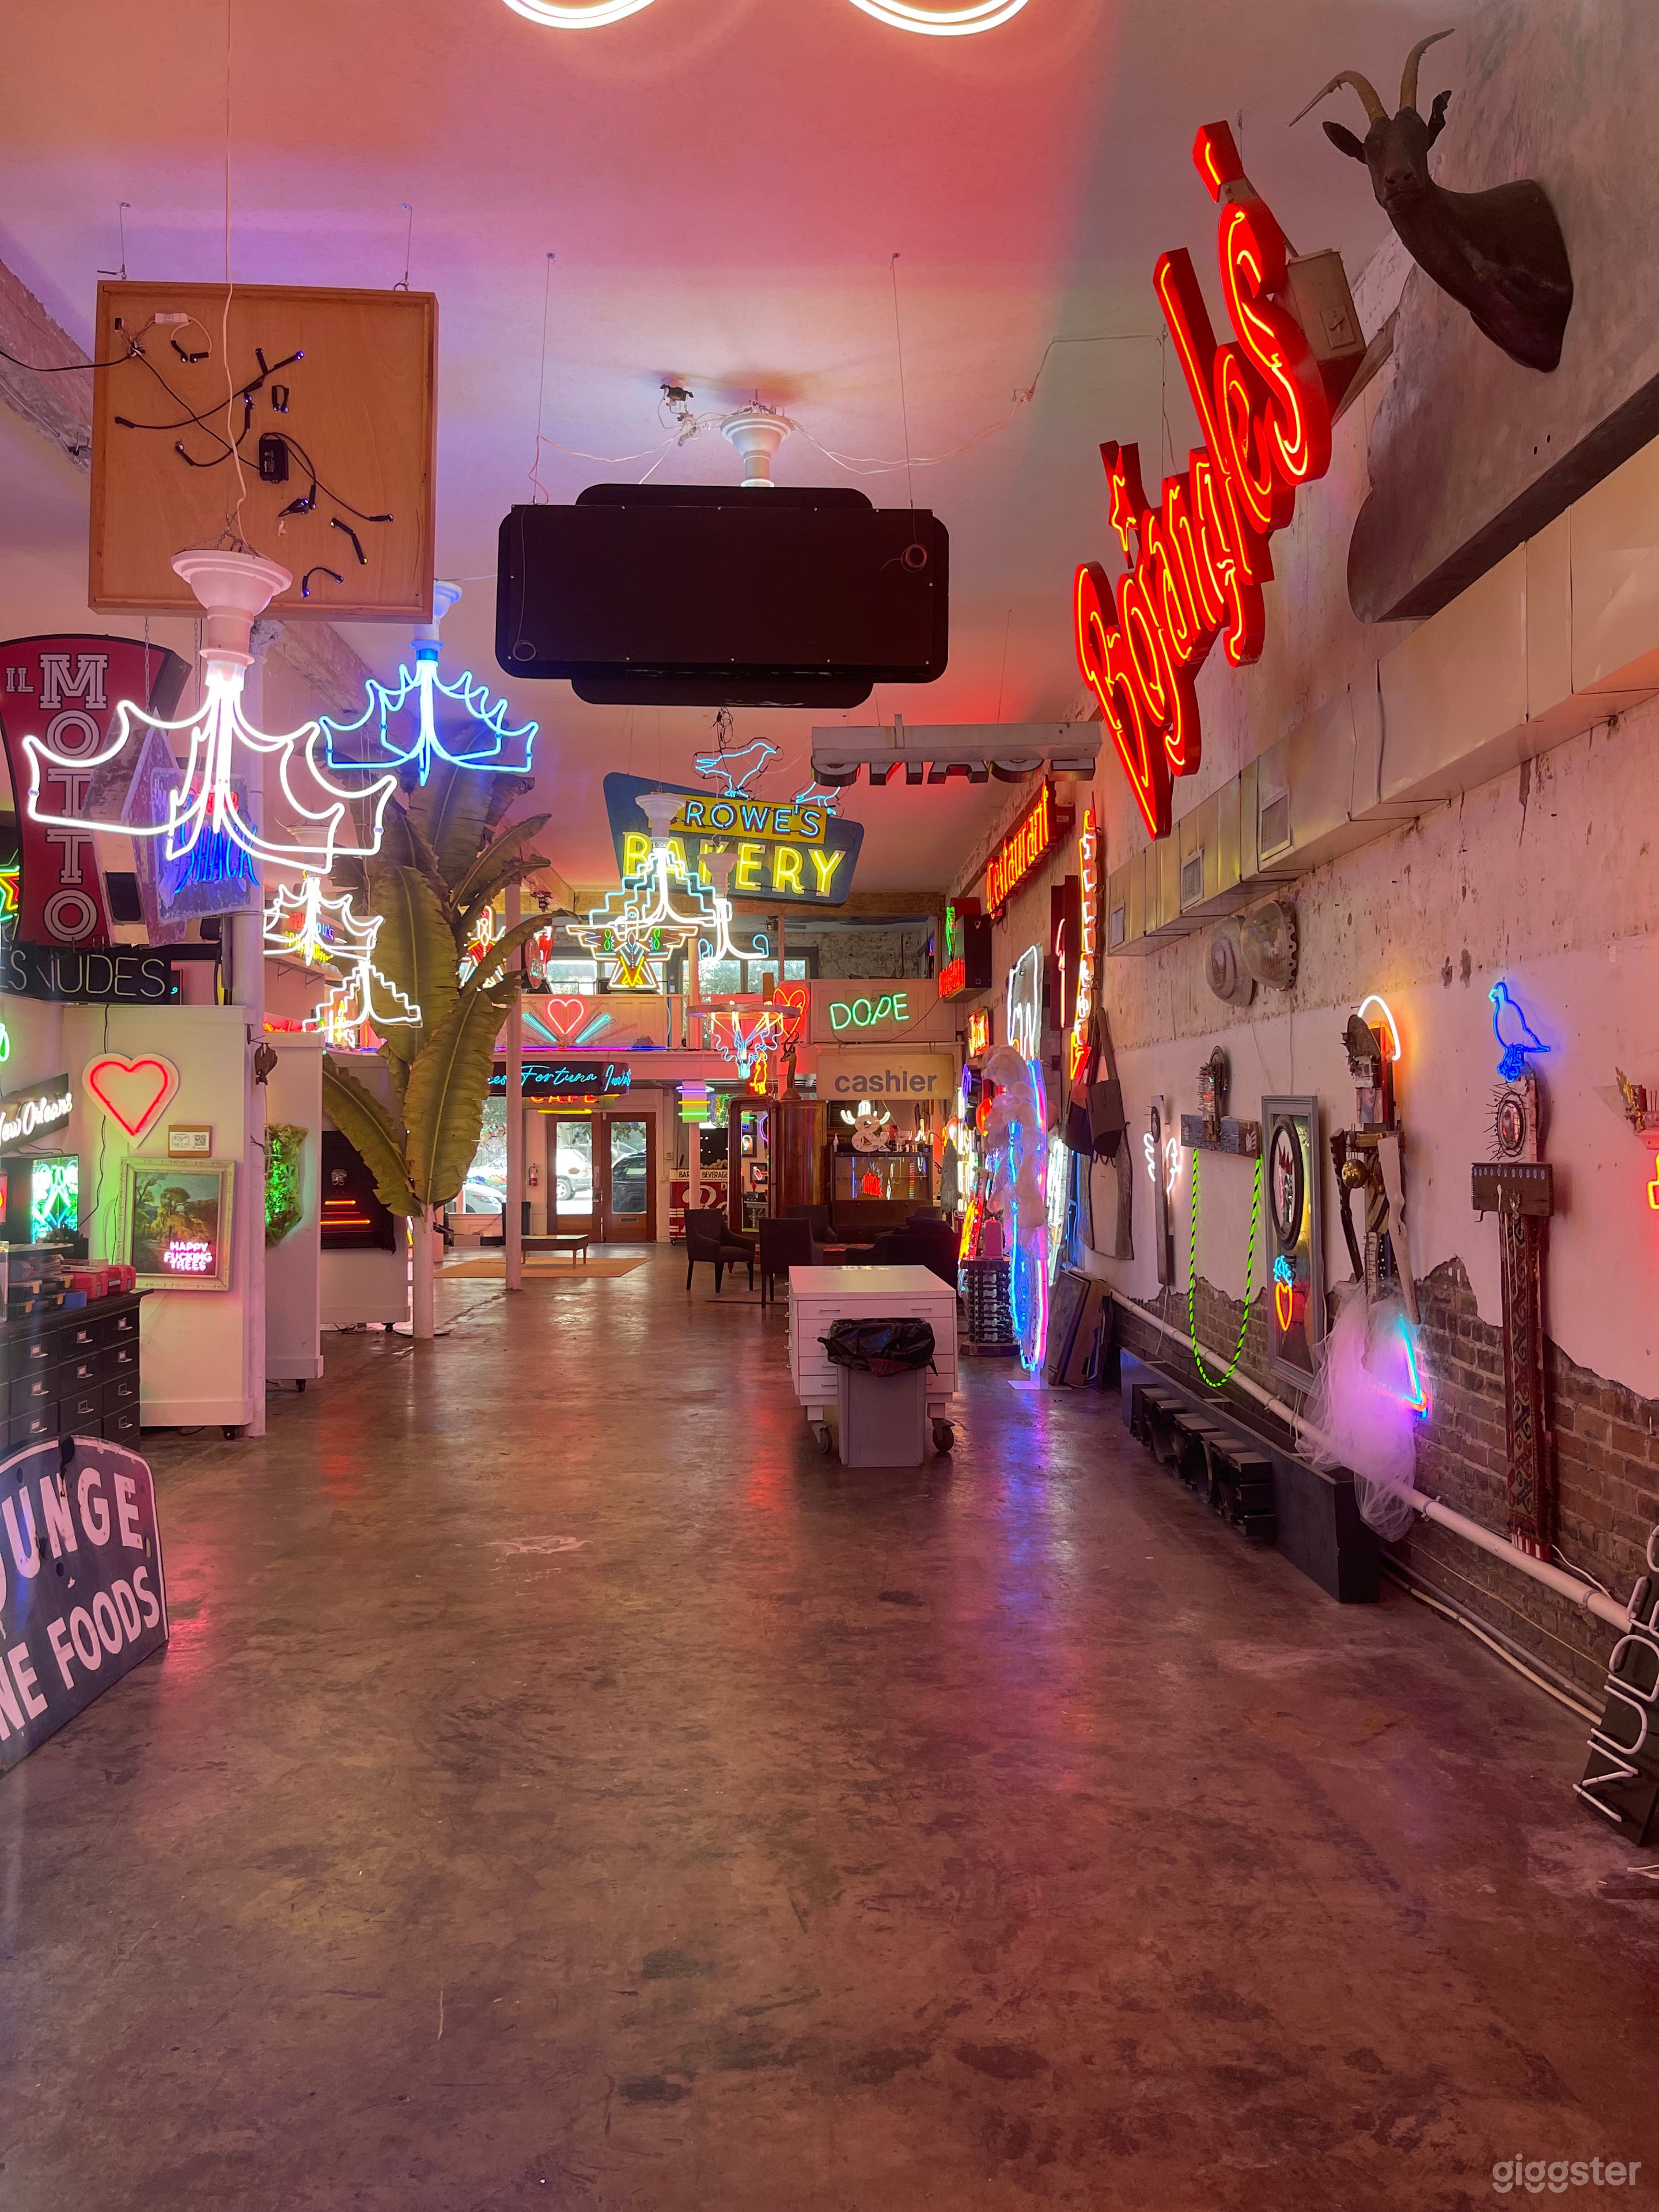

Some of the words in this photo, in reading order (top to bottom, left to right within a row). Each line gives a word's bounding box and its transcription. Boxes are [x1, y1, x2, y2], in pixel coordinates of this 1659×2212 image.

[6, 667, 34, 692] IL
[40, 653, 108, 942] MOTTO
[684, 799, 824, 838] ROWE'S
[830, 993, 910, 1031] DOPE
[521, 1066, 597, 1086] Fortuna
[835, 1070, 938, 1093] cashier
[22, 1092, 73, 1135] Orleans
[164, 1251, 213, 1263] FUCKING
[169, 1240, 209, 1252] HAPPY
[171, 1260, 206, 1271] TREES
[0, 1467, 144, 1612] UNGE
[47, 1565, 161, 1690] FOODS
